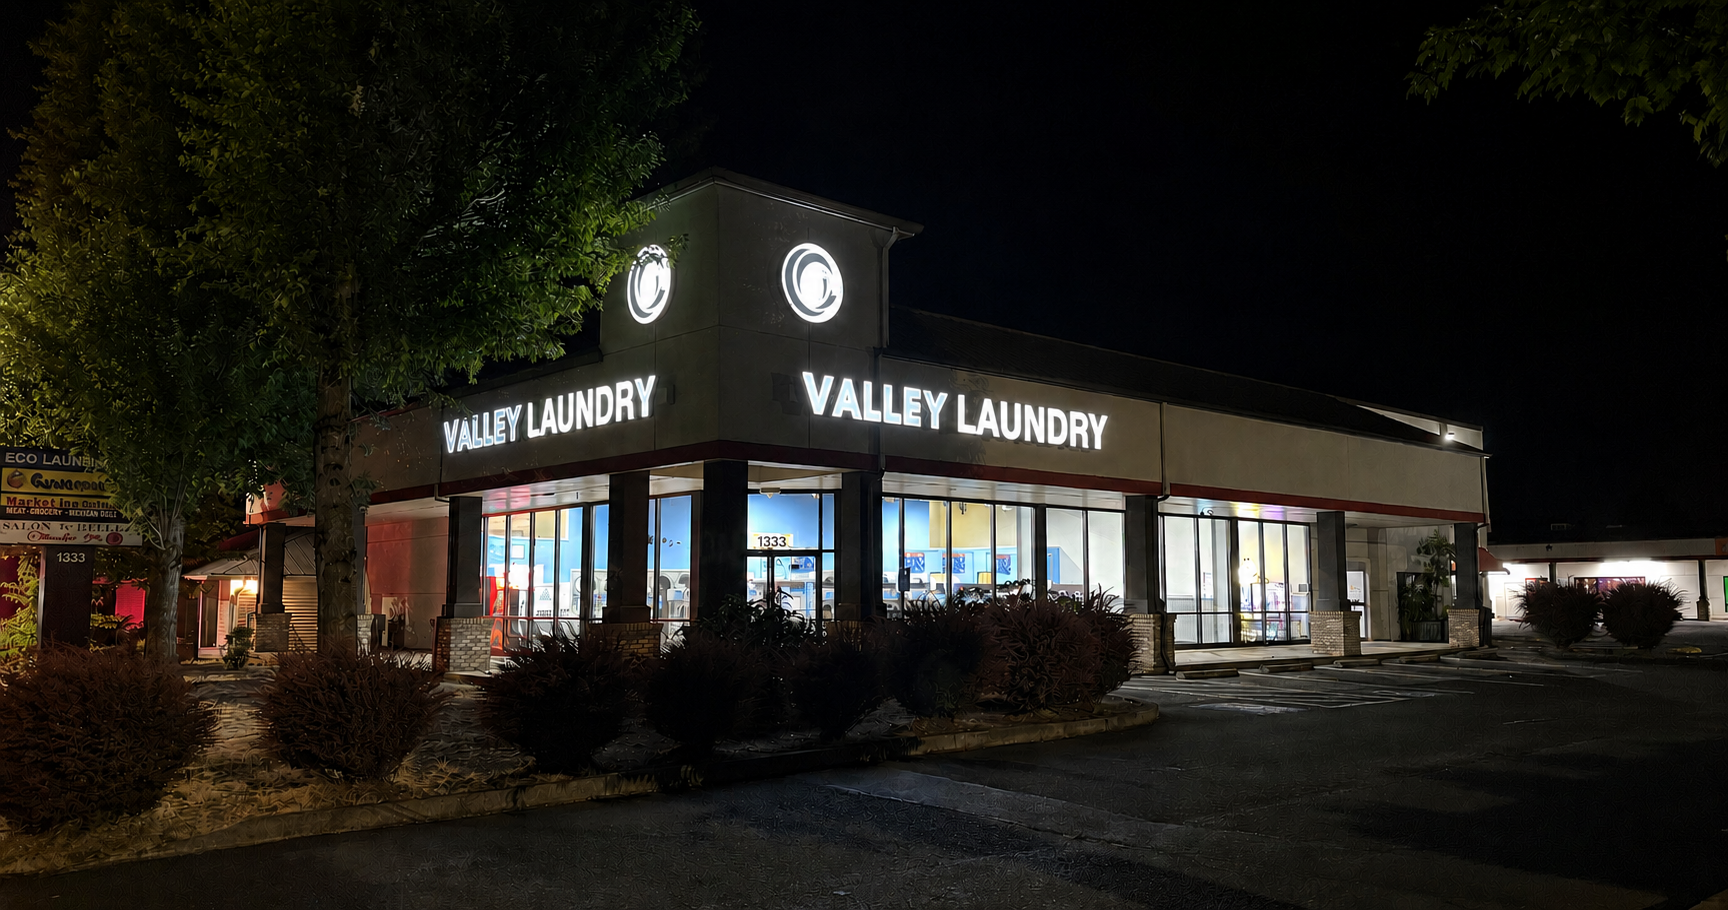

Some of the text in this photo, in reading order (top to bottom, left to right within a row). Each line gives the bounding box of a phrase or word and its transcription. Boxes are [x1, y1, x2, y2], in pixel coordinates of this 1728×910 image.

[444, 375, 656, 453] VALLEY LAUNDRY
[802, 371, 1108, 450] VALLEY LAUNDRY
[5, 452, 38, 464] ECO
[2, 522, 51, 531] SALON
[757, 535, 787, 547] 1333
[56, 552, 86, 563] 1333
